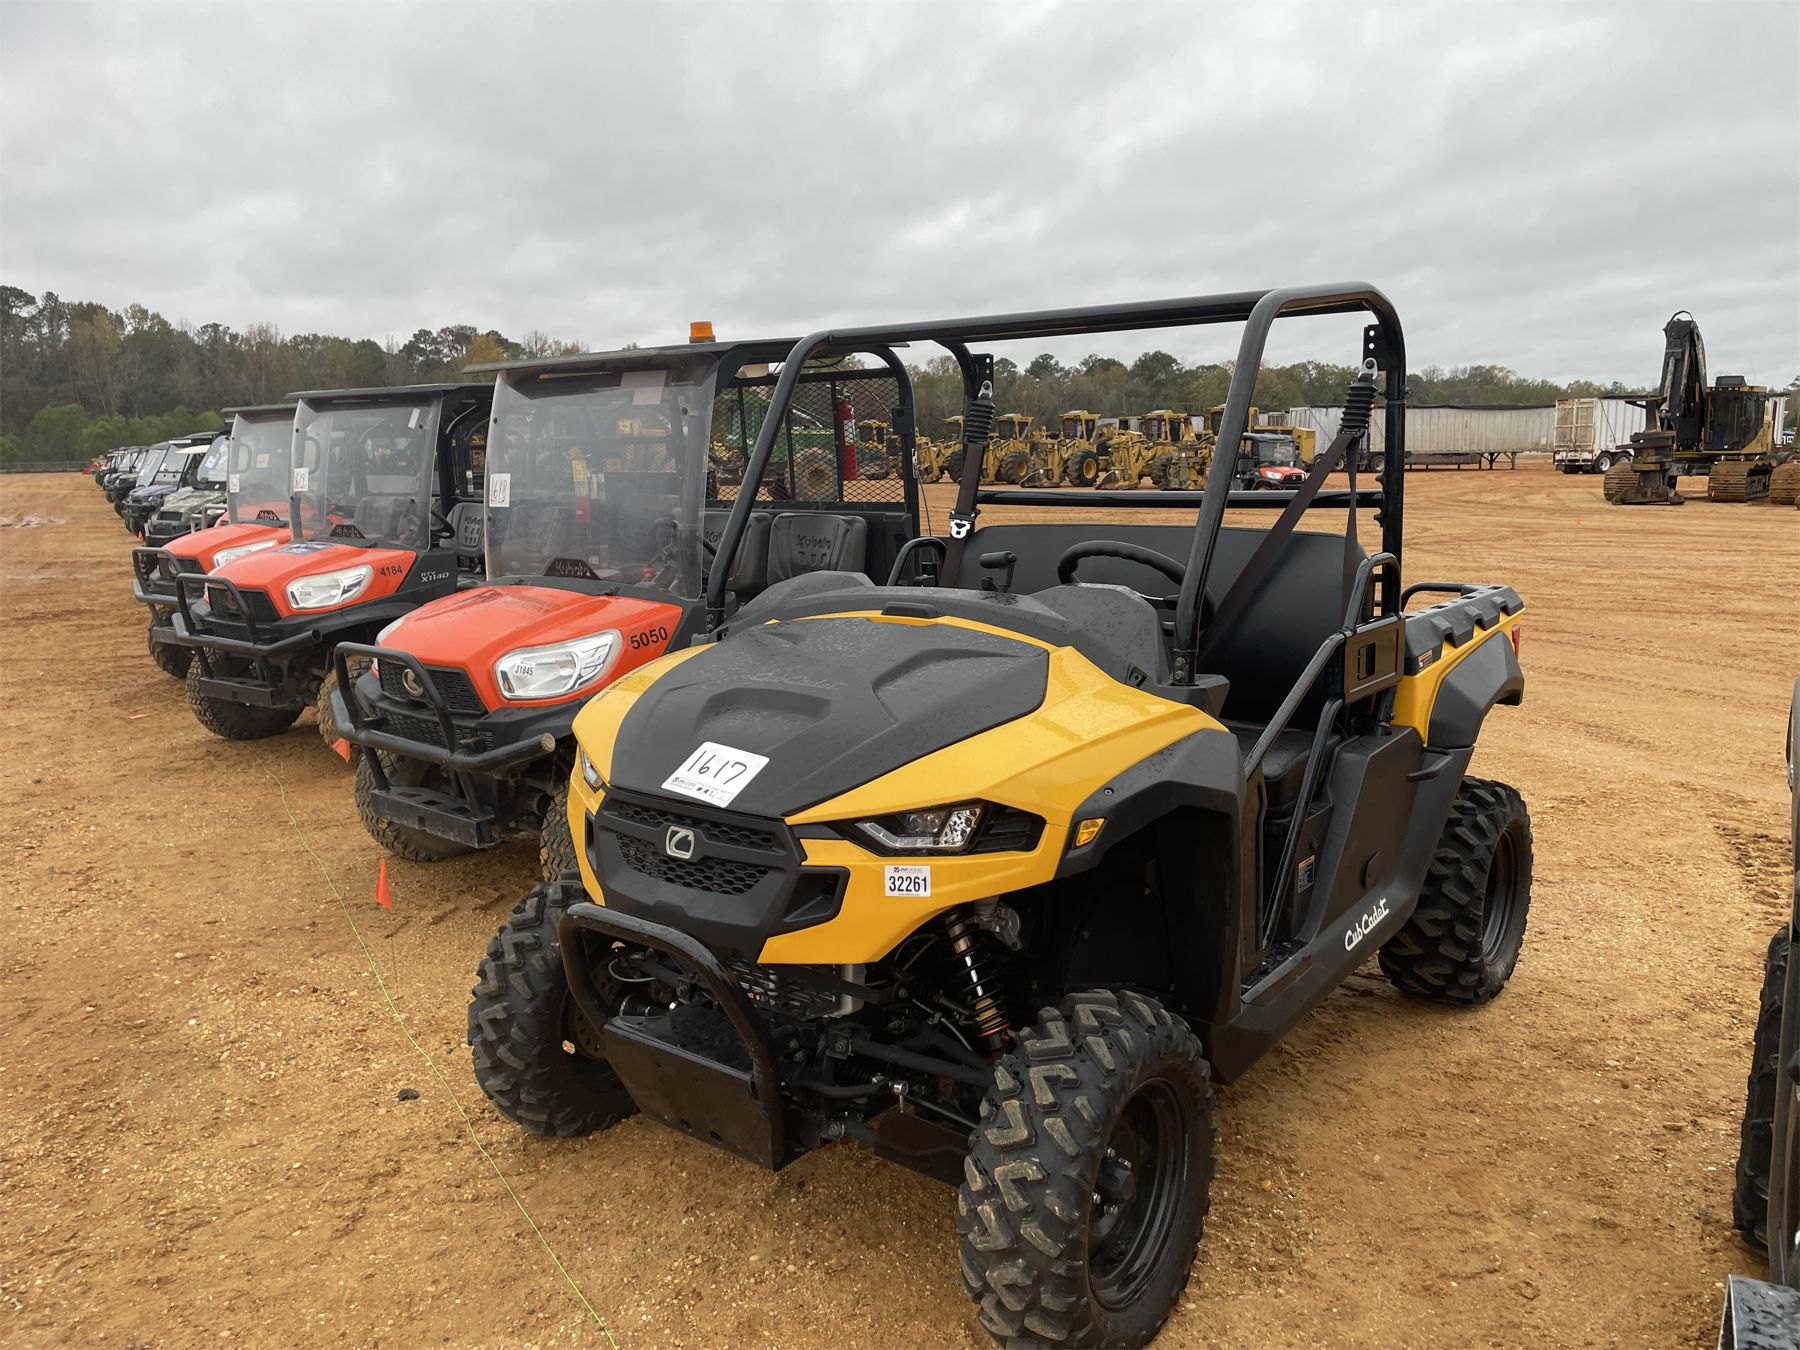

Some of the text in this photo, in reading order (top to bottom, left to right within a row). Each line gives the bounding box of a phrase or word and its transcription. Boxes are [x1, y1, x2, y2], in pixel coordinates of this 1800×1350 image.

[490, 479, 508, 500] 1618
[796, 534, 832, 550] Kubota
[380, 565, 404, 577] 4184
[555, 559, 592, 577] Kubota
[421, 572, 450, 583] X1140
[629, 626, 669, 650] 5050
[514, 664, 534, 676] 31845
[687, 750, 748, 785] 1617
[888, 875, 927, 893] 32261
